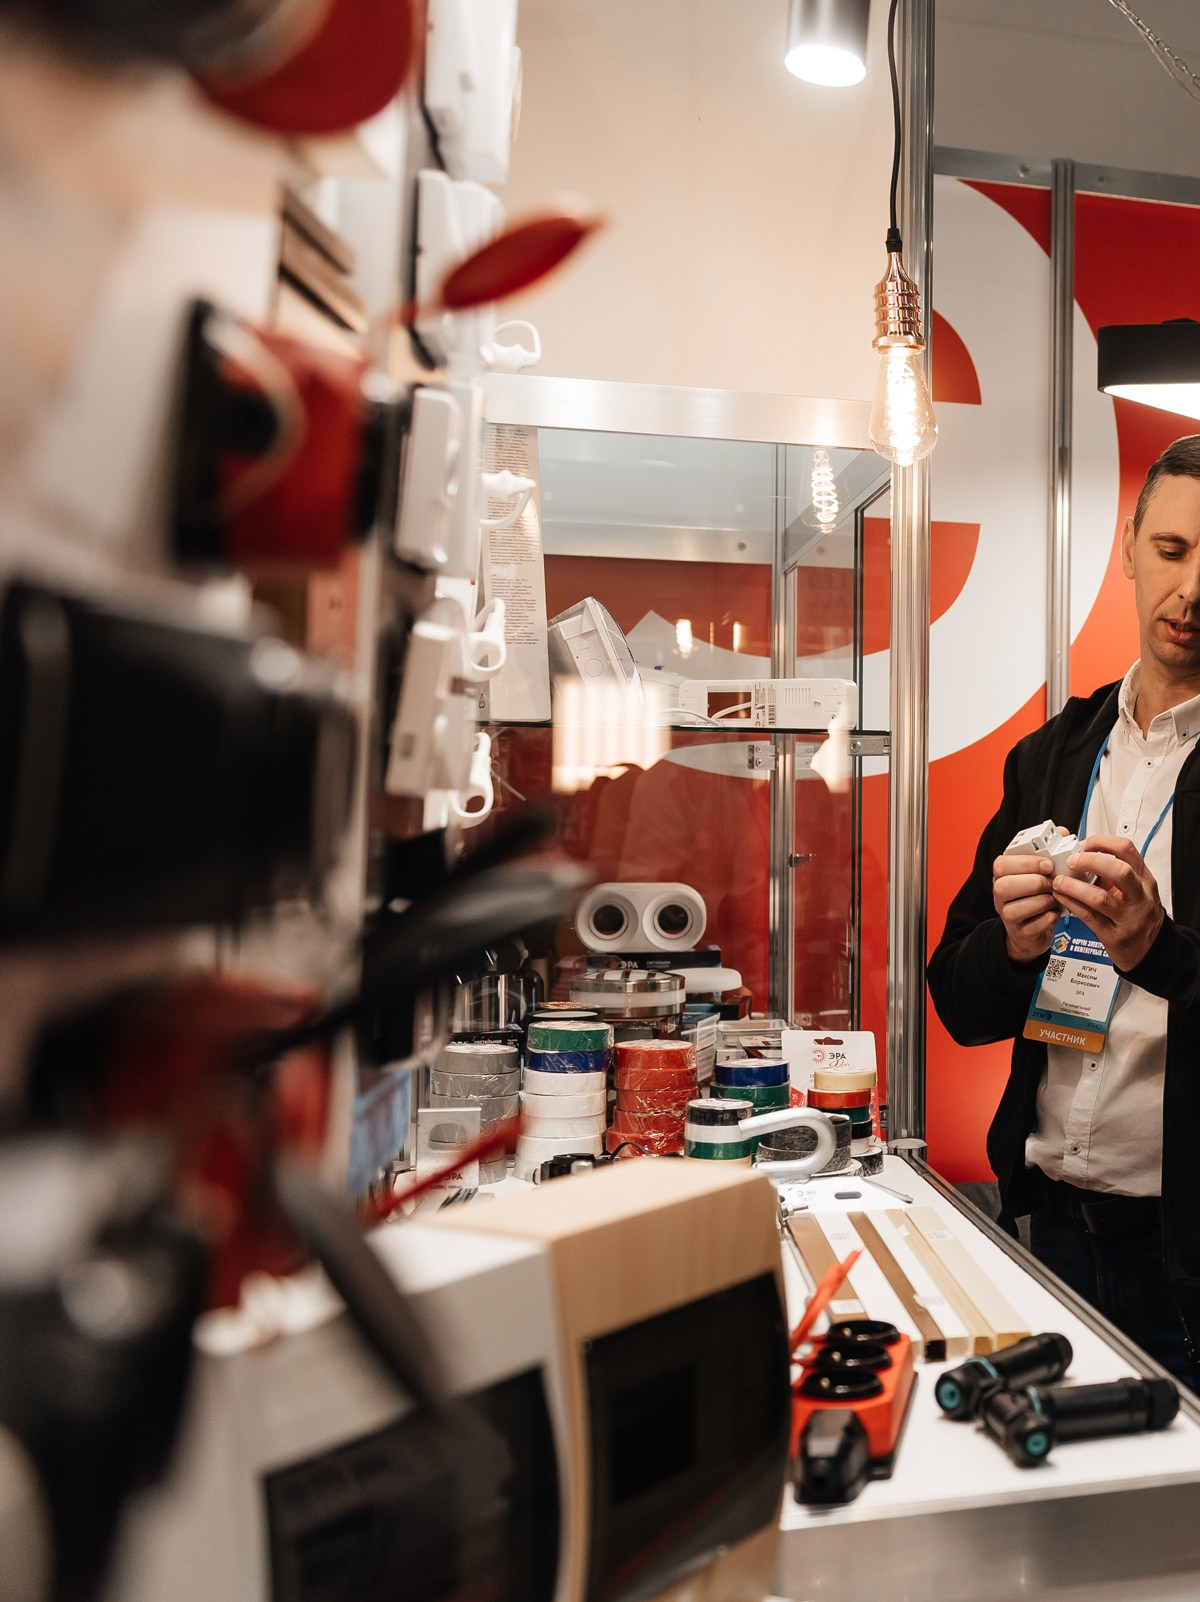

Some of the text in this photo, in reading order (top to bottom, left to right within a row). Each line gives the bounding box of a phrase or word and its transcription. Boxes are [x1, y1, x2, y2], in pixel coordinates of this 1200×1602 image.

[620, 960, 638, 969] ЭРА
[1077, 971, 1098, 980] Максим
[1070, 978, 1100, 989] Борисович
[1039, 1029, 1086, 1046] УЧАСТНИК
[829, 1052, 847, 1060] ЭРА
